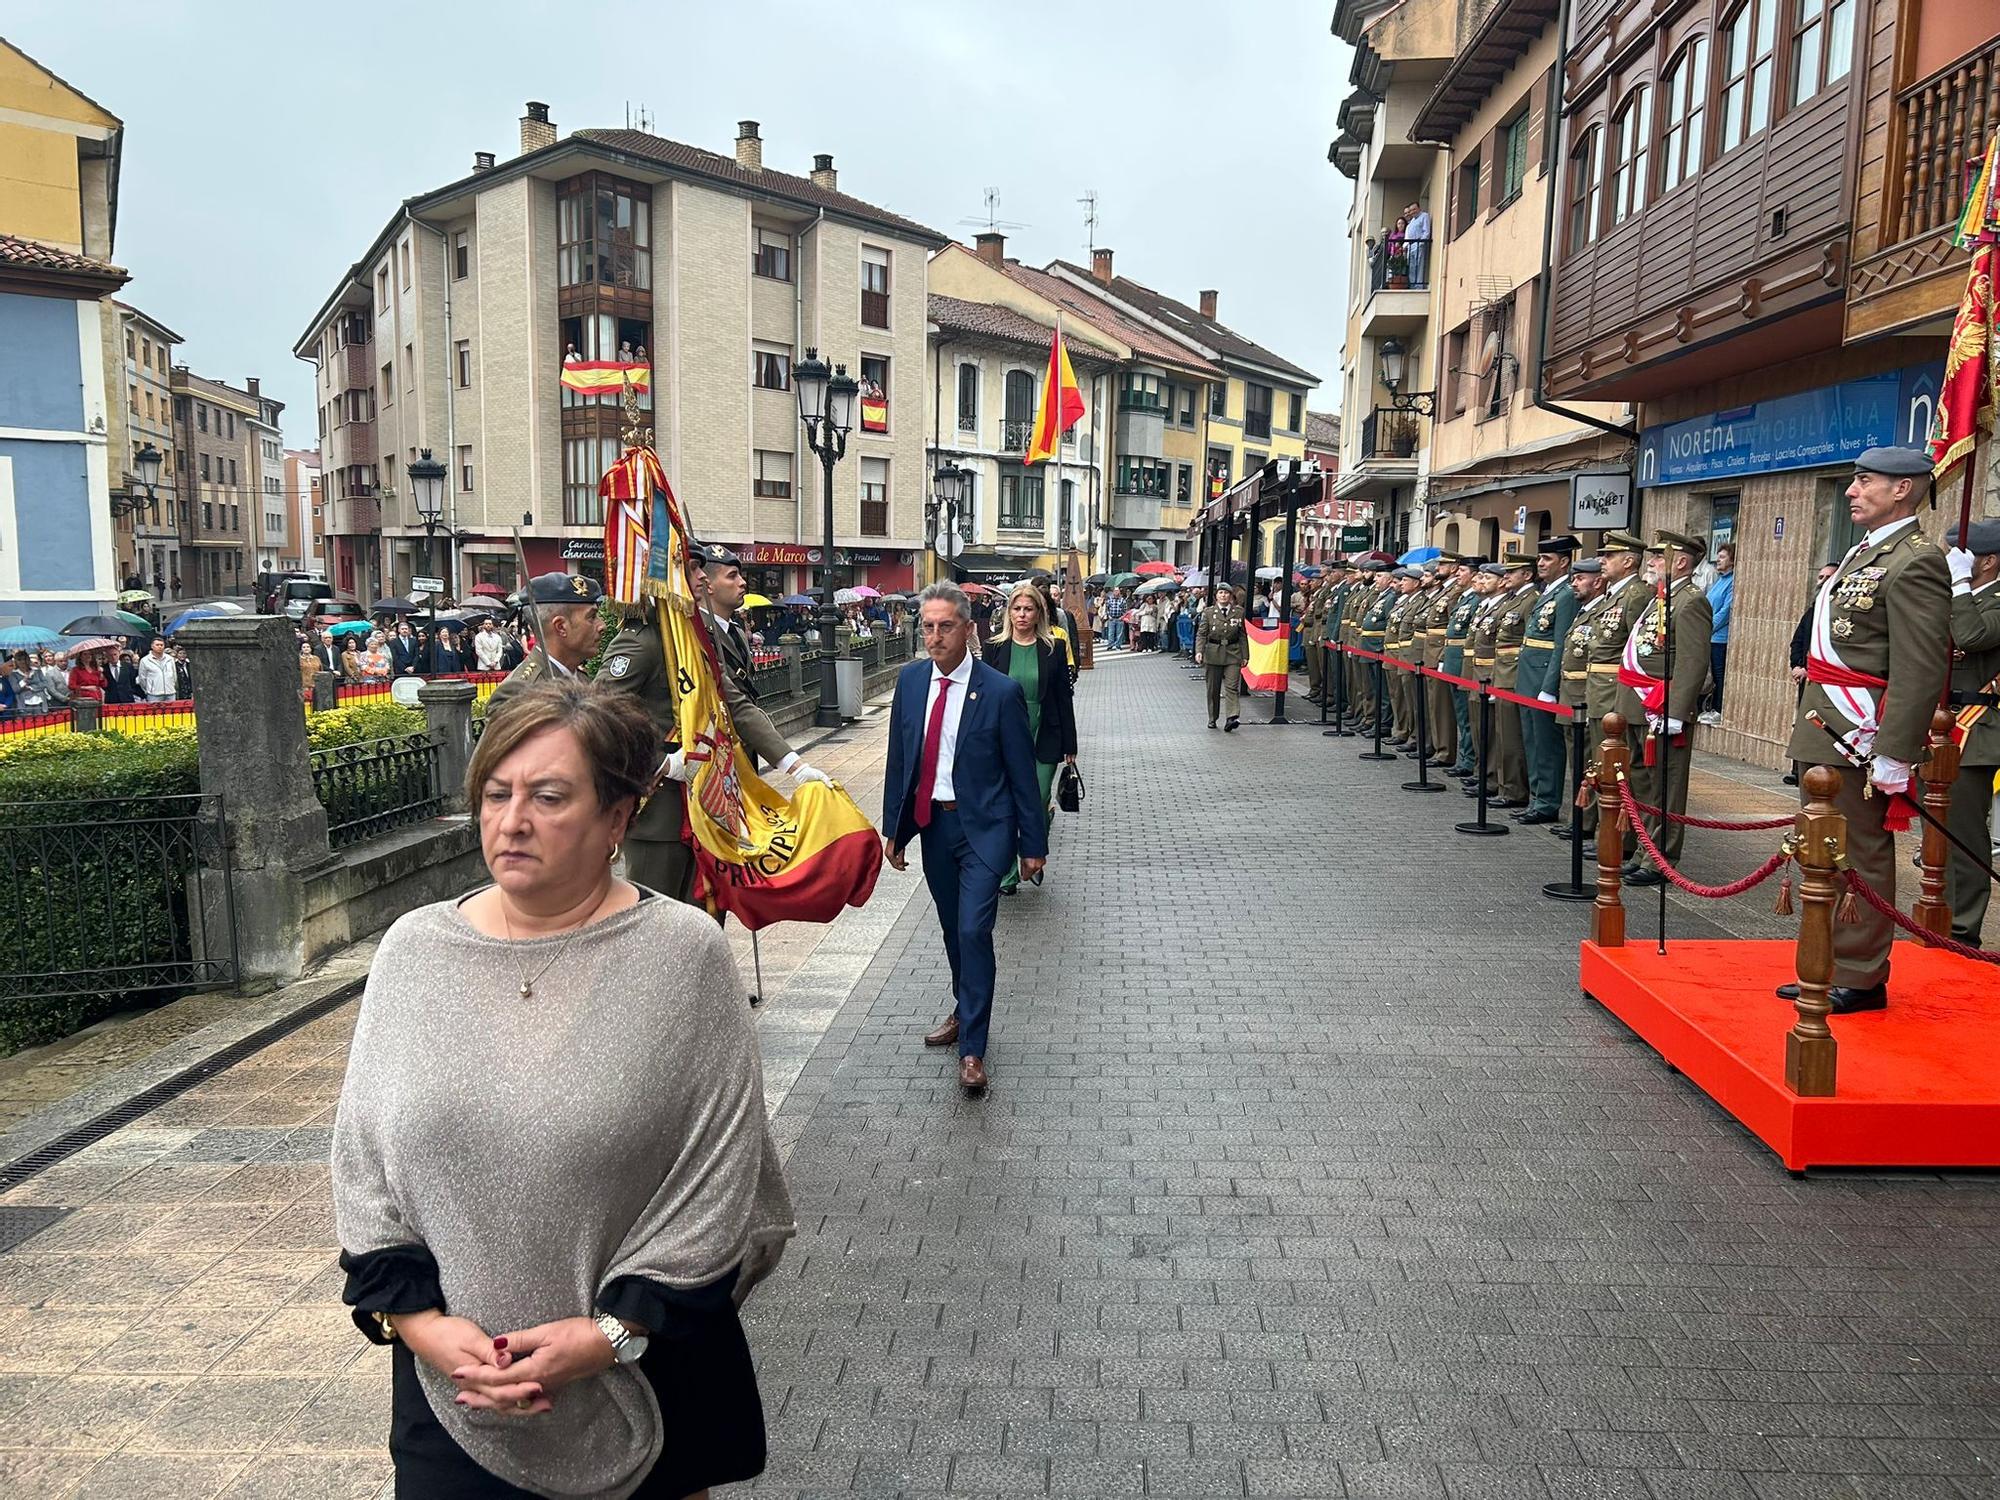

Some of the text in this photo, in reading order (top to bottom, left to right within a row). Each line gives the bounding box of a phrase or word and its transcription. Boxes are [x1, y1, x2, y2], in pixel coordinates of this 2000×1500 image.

[1775, 447, 1796, 460] Locales
[1796, 440, 1835, 457] Comerciales
[1840, 437, 1861, 451] Naves
[568, 540, 604, 549] Carnice
[756, 547, 769, 562] de
[772, 547, 806, 563] Marco
